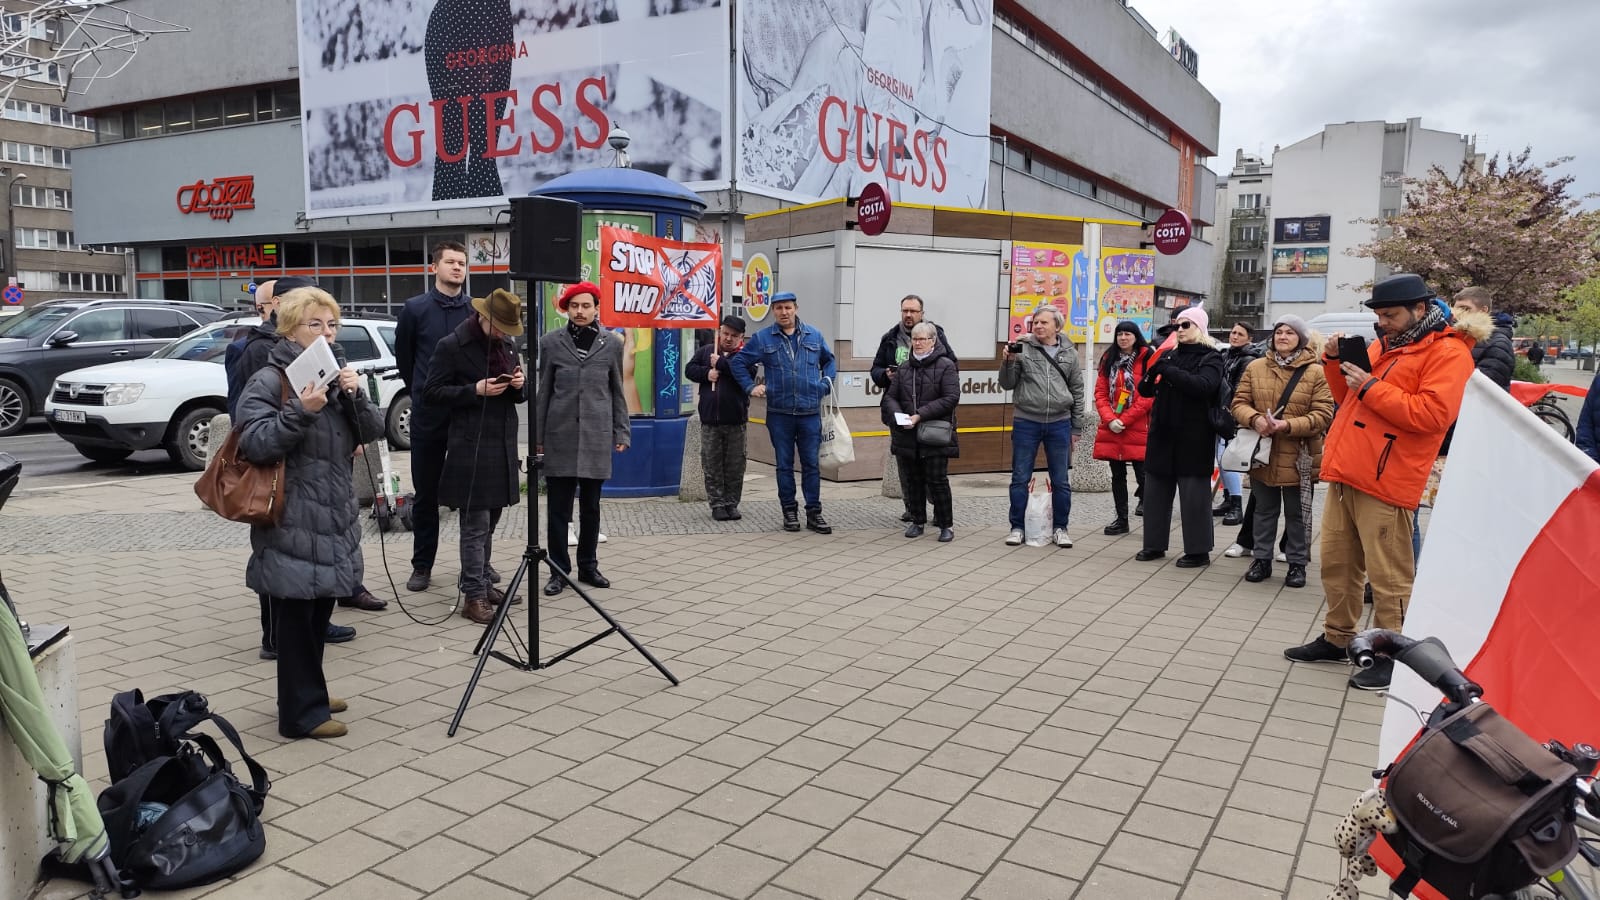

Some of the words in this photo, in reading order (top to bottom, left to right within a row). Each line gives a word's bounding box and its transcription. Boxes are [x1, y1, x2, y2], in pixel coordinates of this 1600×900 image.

[445, 40, 529, 70] GEORGINA
[866, 67, 914, 101] GEORGINA
[383, 76, 609, 167] GUESS
[818, 95, 947, 193] GUESS
[859, 201, 885, 217] COSTA
[1156, 227, 1185, 238] COSTA
[610, 241, 655, 275] STOP
[614, 282, 659, 314] WHO
[865, 378, 884, 396] lo
